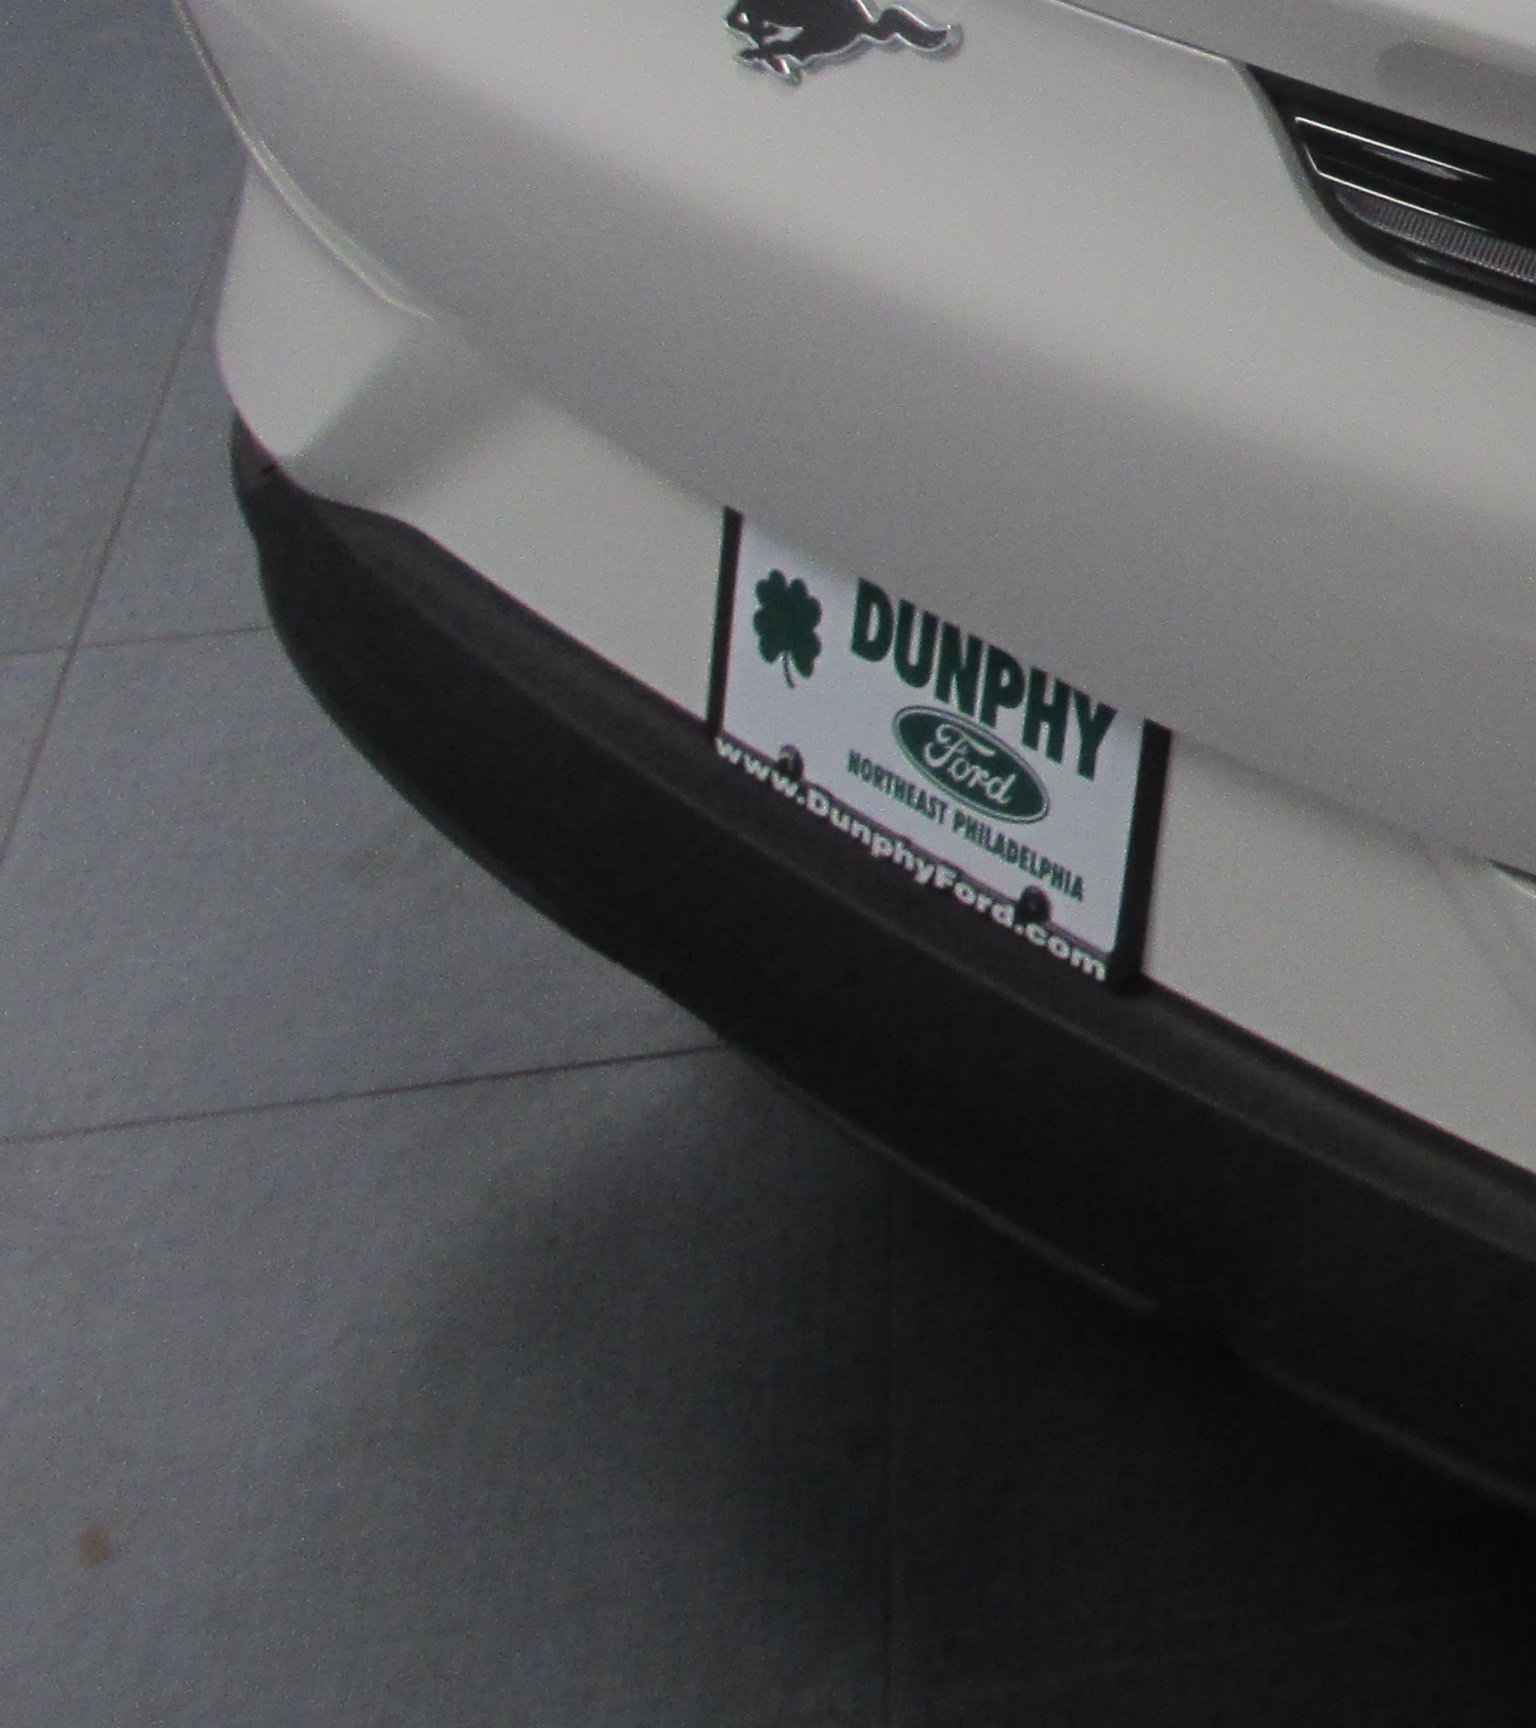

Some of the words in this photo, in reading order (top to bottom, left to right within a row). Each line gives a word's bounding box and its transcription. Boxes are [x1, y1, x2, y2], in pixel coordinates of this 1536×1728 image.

[851, 576, 1119, 782] DUNPHY
[922, 723, 1017, 805] Ford
[715, 737, 1106, 981] www.DunphyFord.com
[847, 749, 947, 825] NORTHEAST
[952, 808, 1083, 902] PHILADELPHIA
